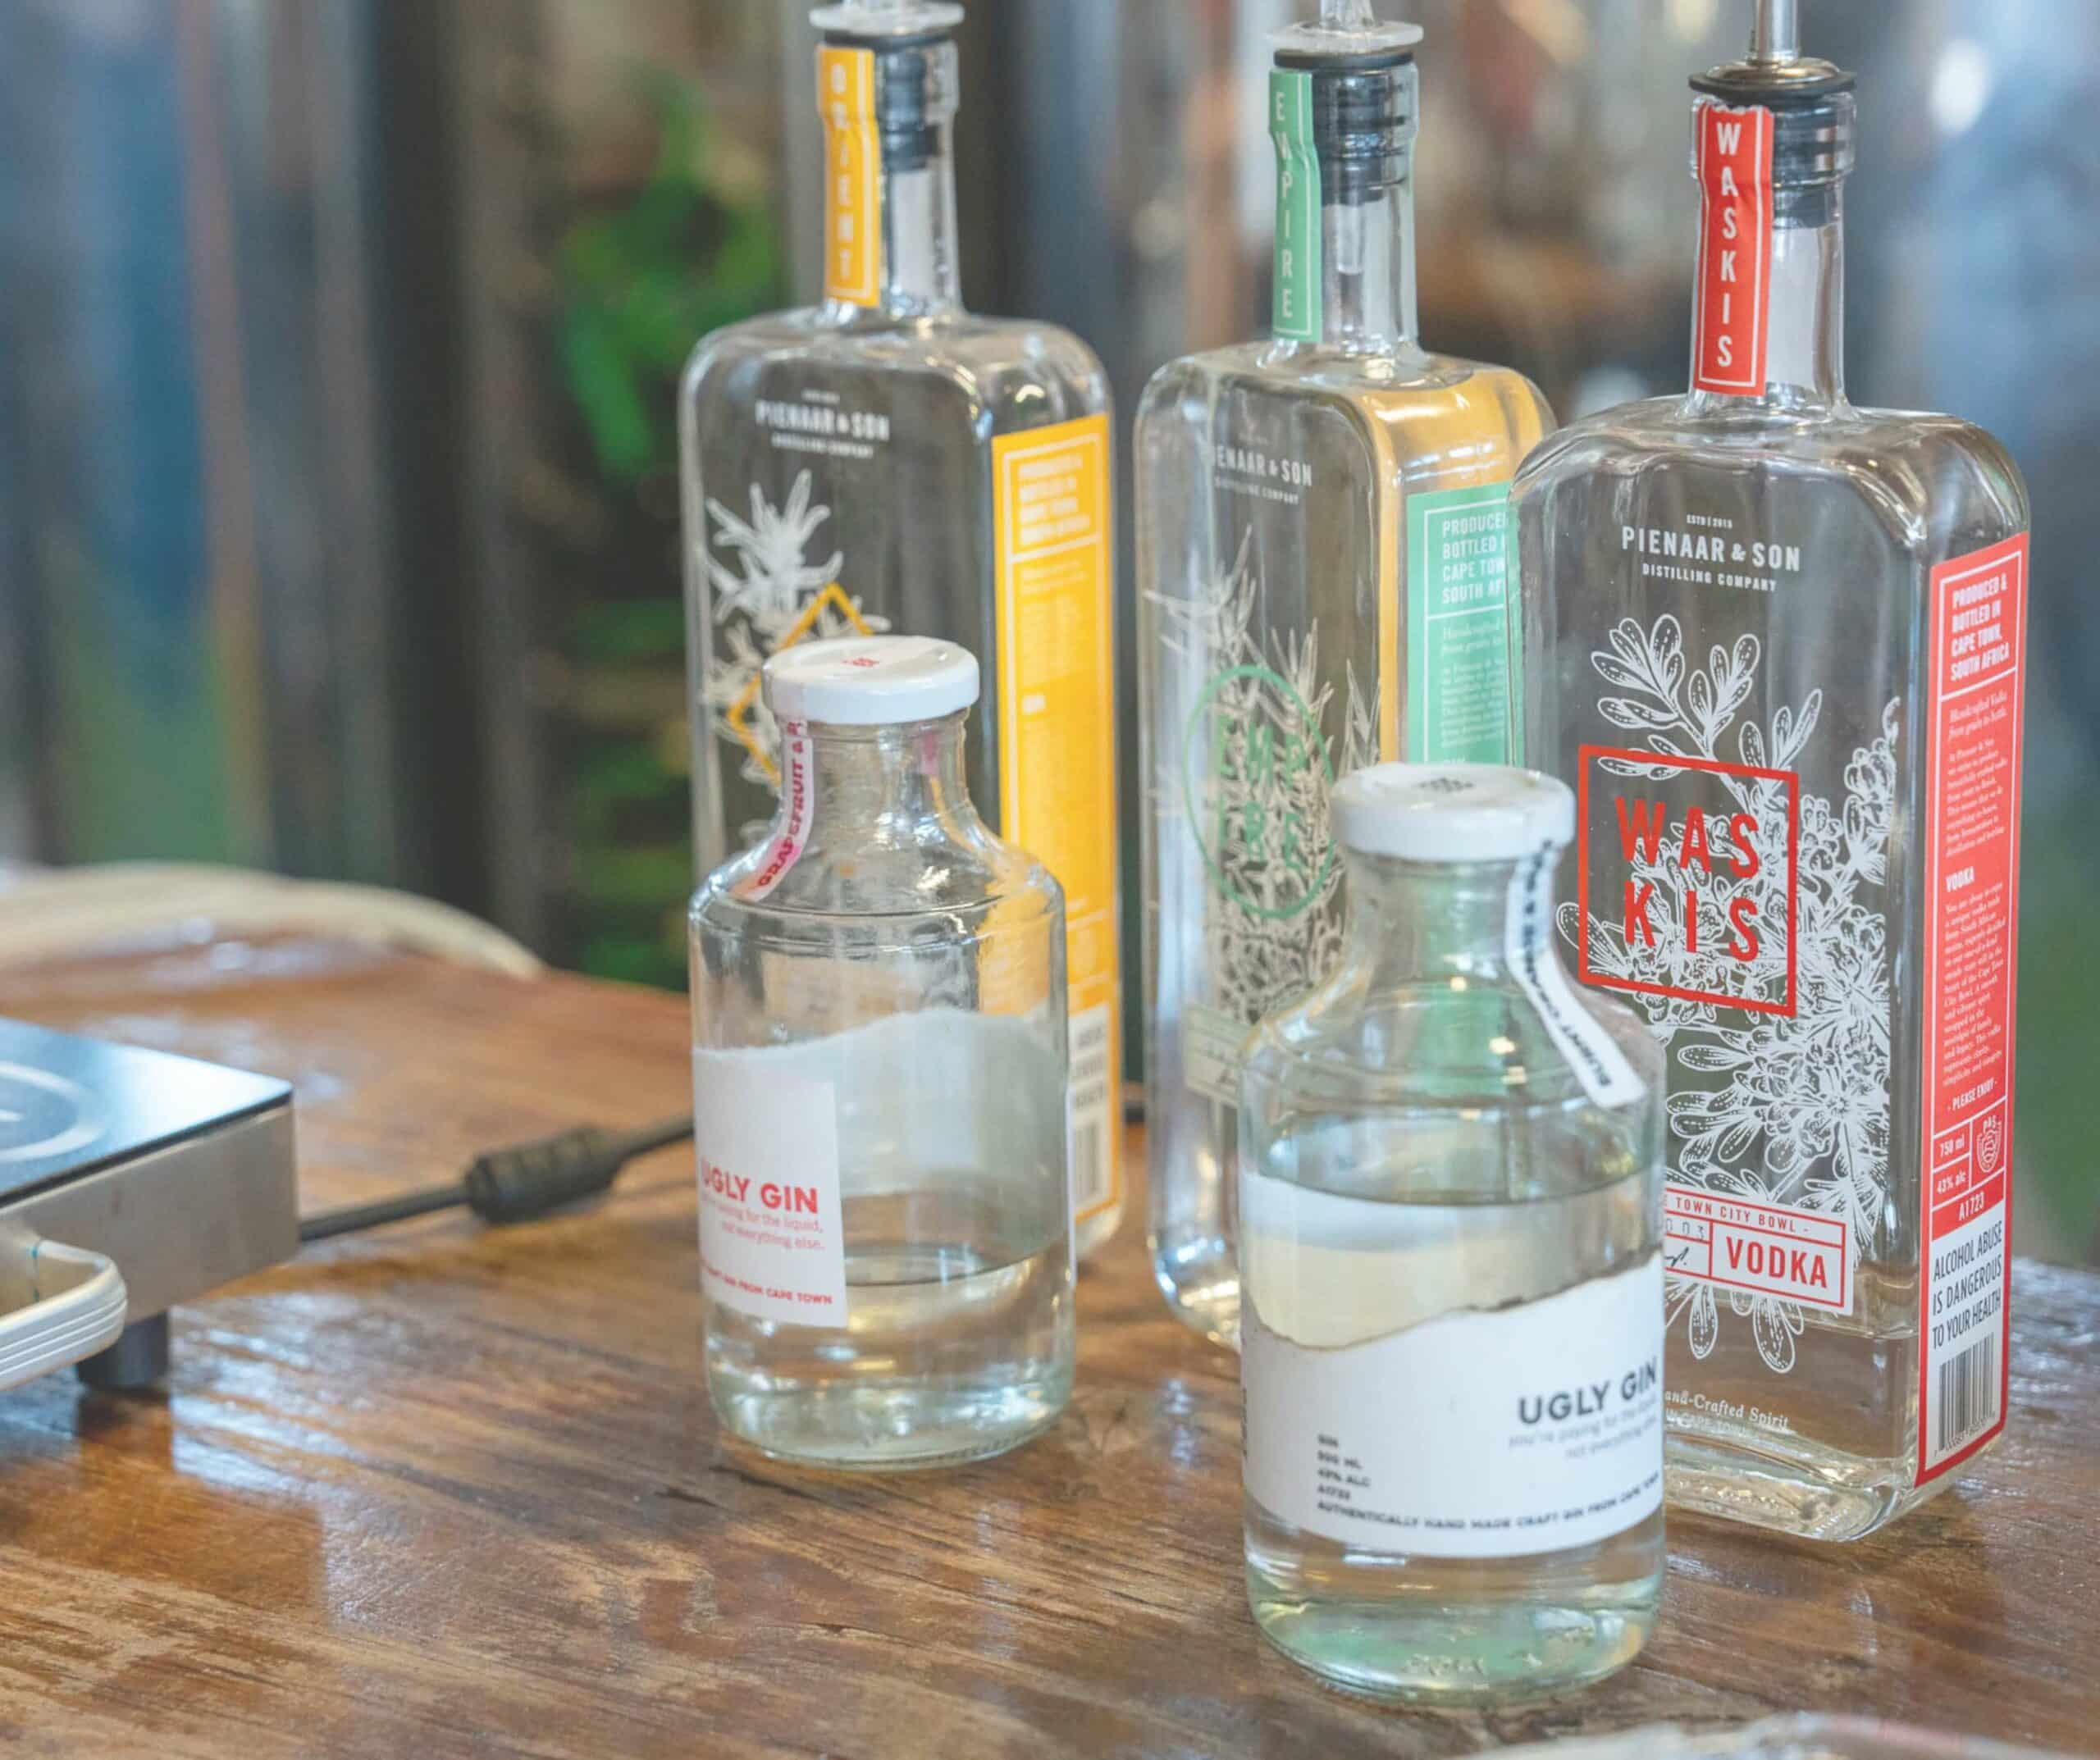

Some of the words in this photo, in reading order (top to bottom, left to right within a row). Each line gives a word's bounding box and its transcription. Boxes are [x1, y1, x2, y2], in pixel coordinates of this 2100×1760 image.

[1715, 121, 1742, 368] WASKIS
[1281, 458, 1312, 487] SON
[1442, 536, 1496, 560] BOTTLED
[1621, 525, 1725, 563] PIENAAR
[1731, 543, 1746, 562] &
[1752, 541, 1801, 572] SON
[1443, 560, 1475, 583] CAPE
[1642, 563, 1712, 584] DISTILLING
[1718, 572, 1777, 592] COMPANY
[1441, 583, 1484, 605] SOUTH
[1952, 632, 1976, 657] CAPE
[1952, 1087, 1976, 1111] PLEASE
[760, 1183, 819, 1215] GIN
[1676, 1197, 1713, 1215] TOWN
[1719, 1206, 1751, 1223] CITY
[1758, 1215, 1796, 1233] BOWL
[1958, 1192, 1985, 1222] A1723
[1725, 1235, 1828, 1289] VODKA
[1933, 1240, 1974, 1283] ALCOHOL
[1976, 1220, 2002, 1257] ABUSE
[765, 1287, 793, 1302] CAPE
[797, 1292, 833, 1306] TOWN
[1933, 1290, 1943, 1316] IS
[1947, 1253, 2002, 1308] DANGEROUS
[1932, 1324, 1944, 1350] TO
[1947, 1310, 1970, 1342] YOUR
[1972, 1286, 2002, 1327] HEALTH
[1519, 1379, 1611, 1425] UGLY
[1621, 1355, 1657, 1401] GIN
[1664, 1389, 1744, 1420] and-Crafted
[1749, 1407, 1790, 1431] Spirit
